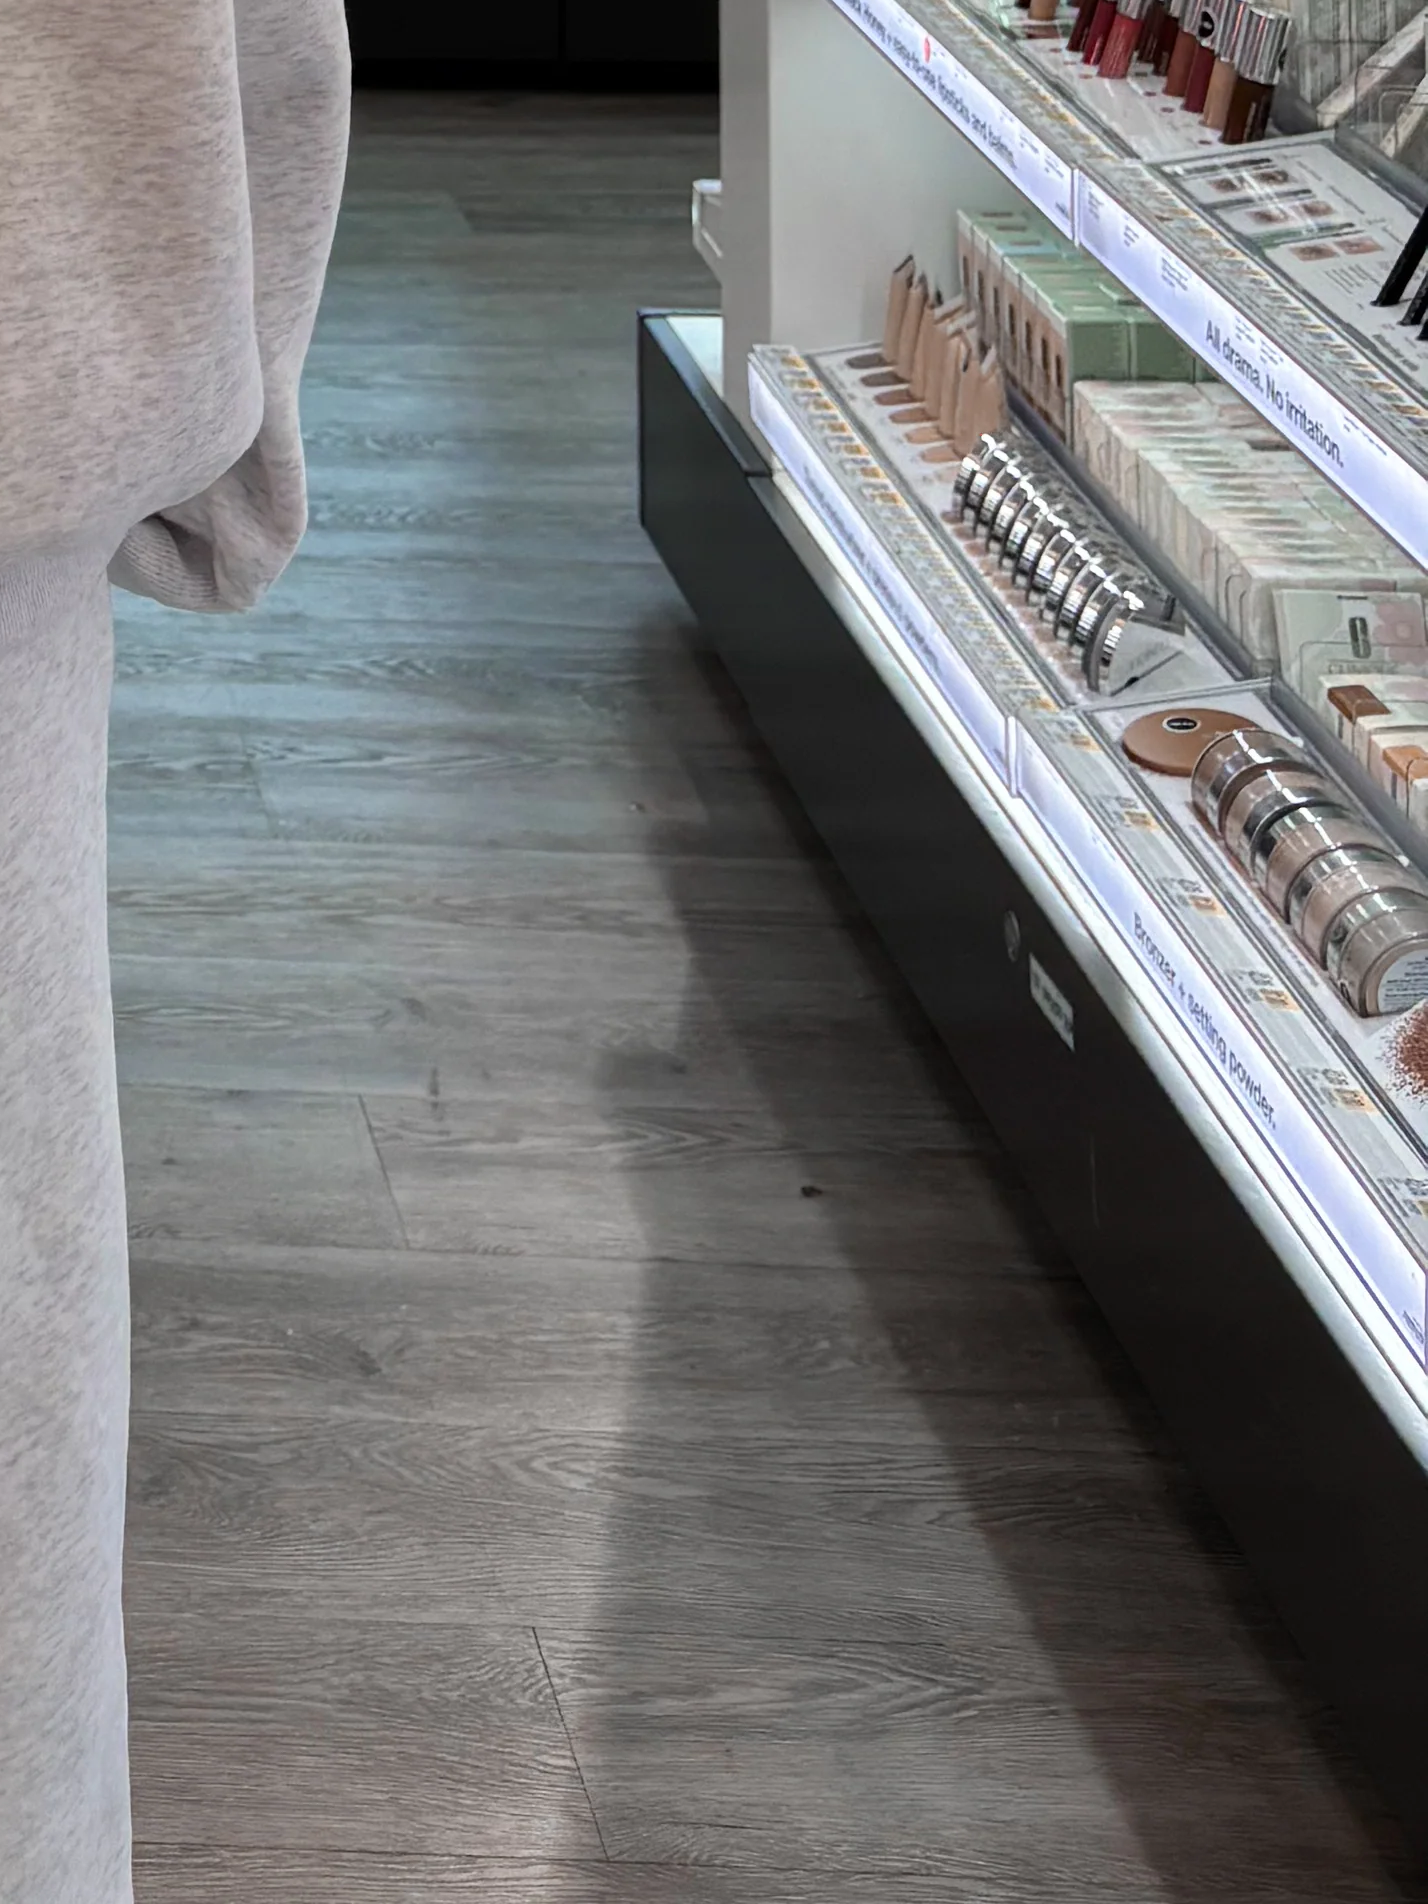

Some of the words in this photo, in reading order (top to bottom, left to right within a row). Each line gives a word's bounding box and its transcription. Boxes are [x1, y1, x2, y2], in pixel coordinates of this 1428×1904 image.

[1205, 319, 1221, 356] All
[1222, 340, 1264, 394] drama.
[1266, 374, 1285, 412] No
[1285, 389, 1344, 468] irritation.
[1133, 910, 1177, 989] Bronzer
[1187, 992, 1227, 1067] setting
[1229, 1050, 1278, 1132] powder.
